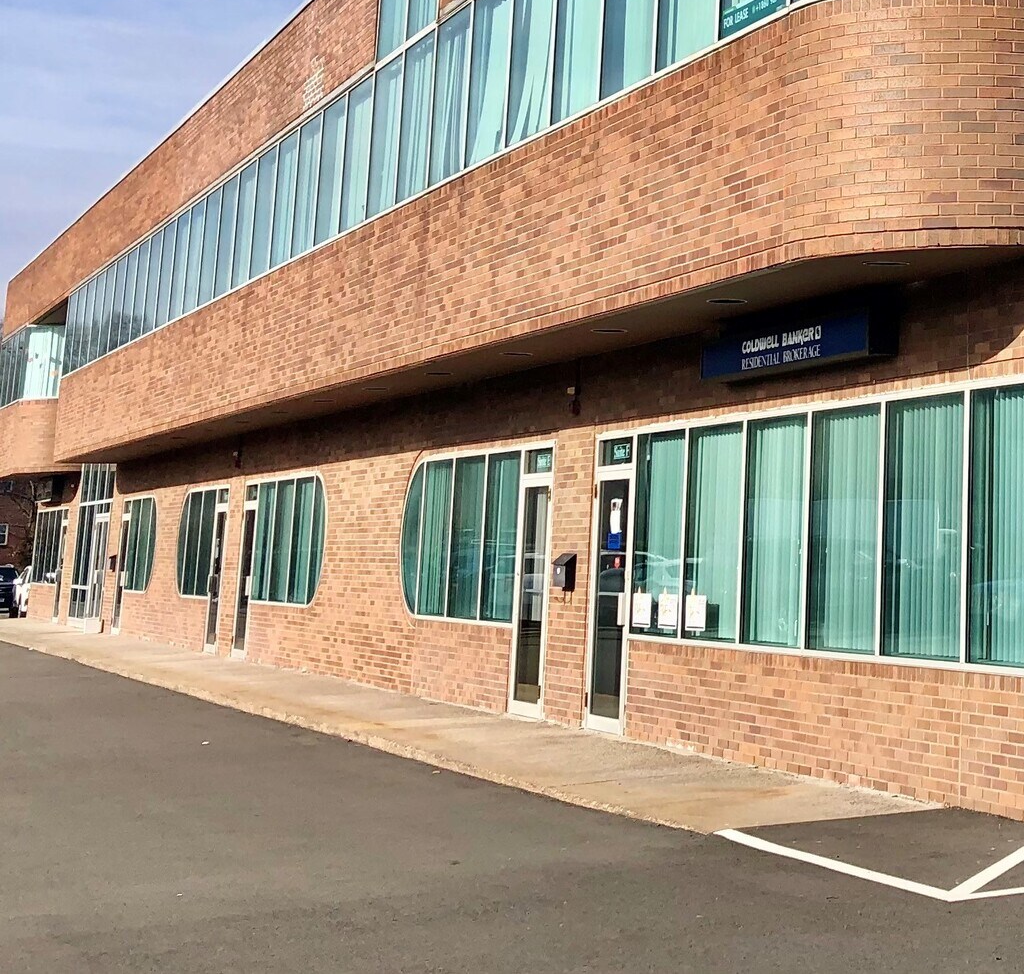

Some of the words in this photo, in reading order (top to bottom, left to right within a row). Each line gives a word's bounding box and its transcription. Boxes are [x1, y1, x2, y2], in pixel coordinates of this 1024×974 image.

[723, 16, 734, 29] FOR
[735, 7, 749, 23] LEASE
[741, 334, 779, 355] COLDWELL
[781, 326, 814, 347] BANKER
[741, 352, 781, 370] RESIDENTIAL
[783, 344, 821, 364] BROKERAGE
